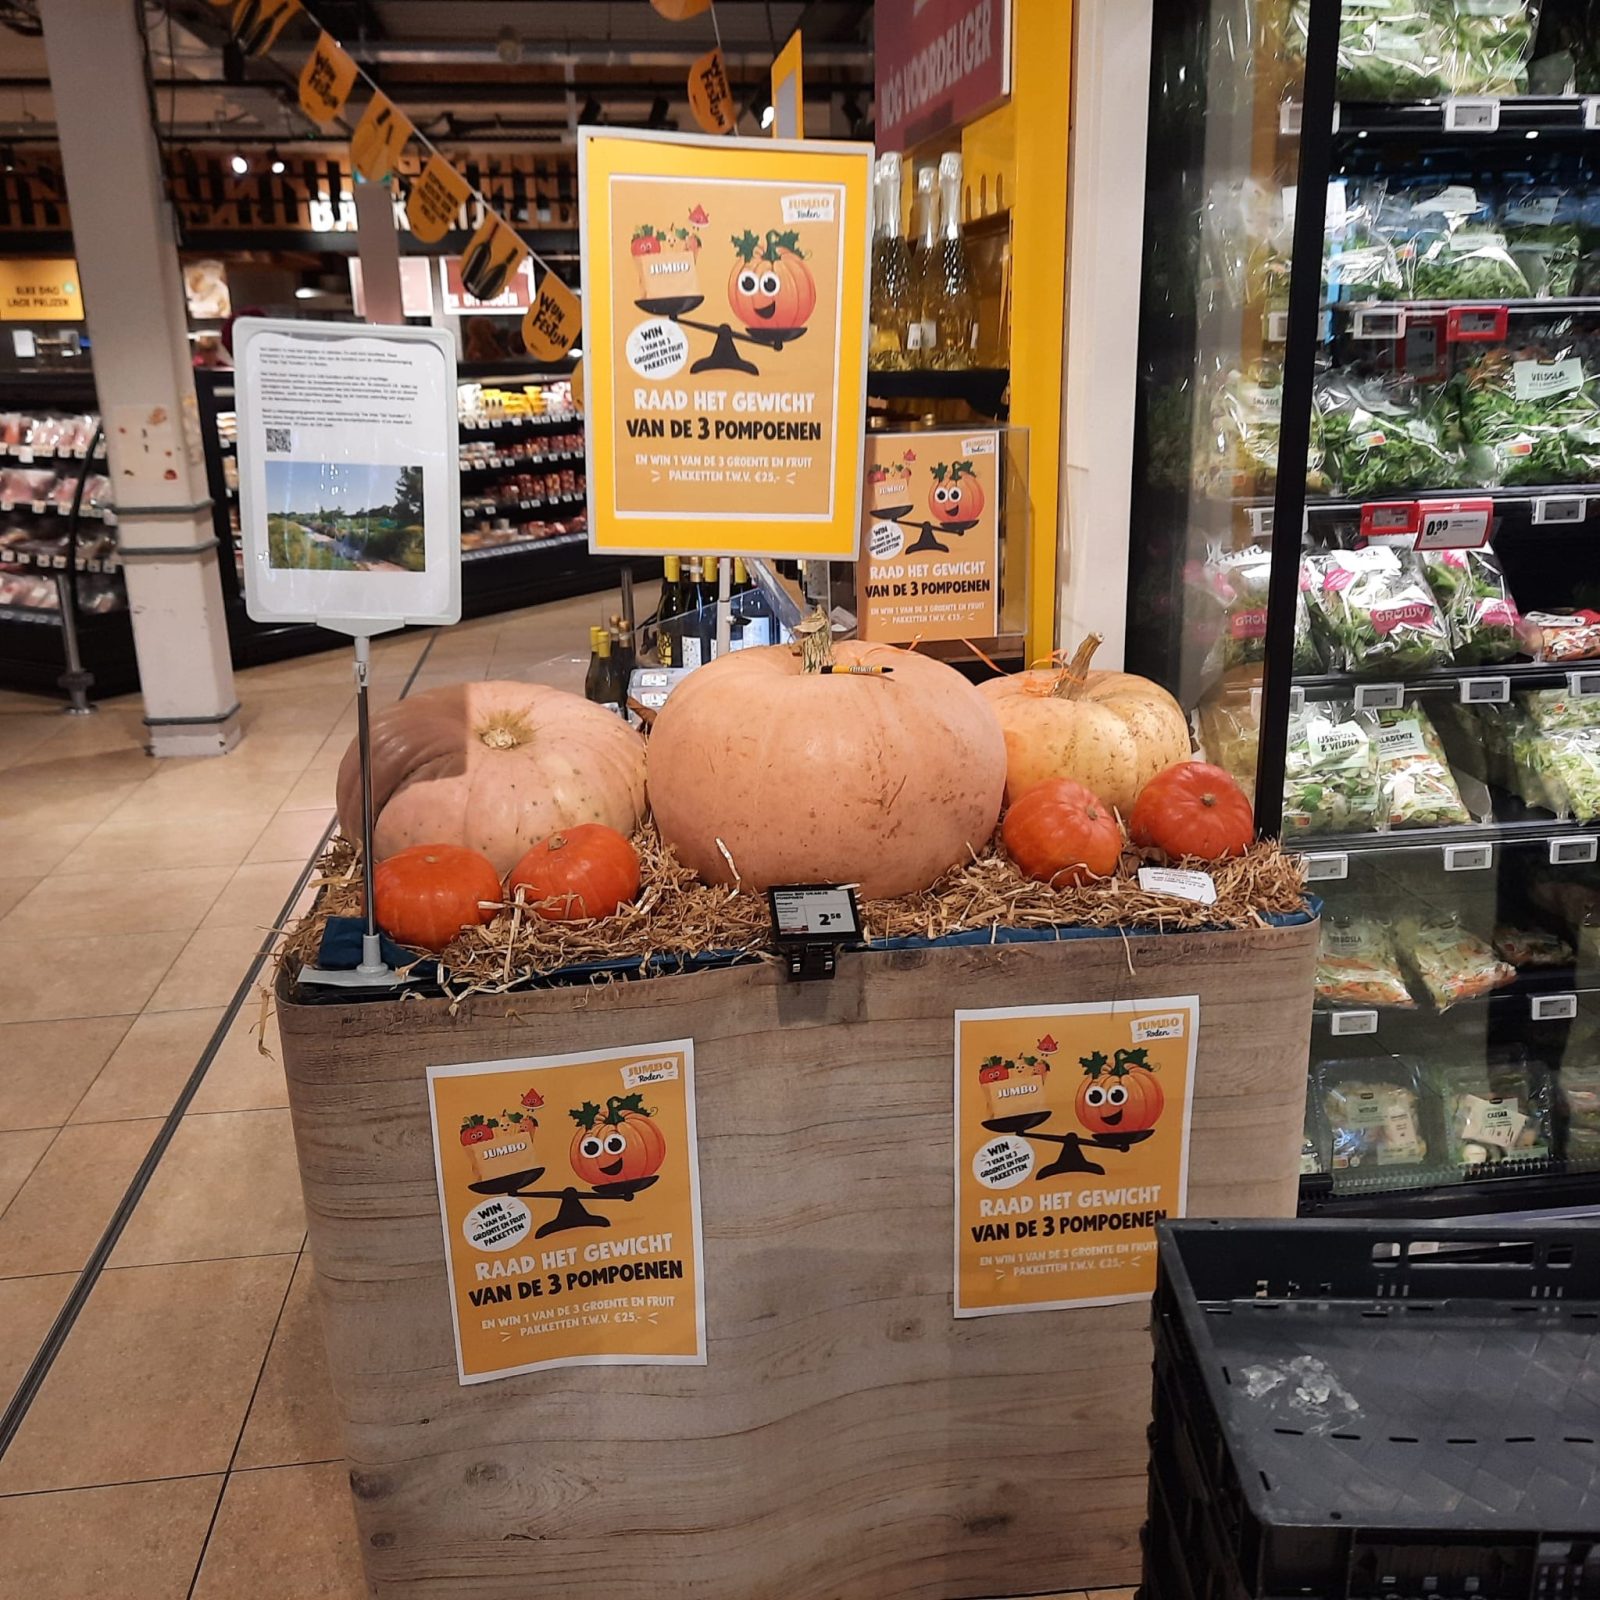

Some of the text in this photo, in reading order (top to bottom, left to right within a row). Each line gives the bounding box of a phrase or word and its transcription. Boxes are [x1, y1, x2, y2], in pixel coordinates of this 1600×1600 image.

[903, 0, 992, 115] VOORDELIGER
[788, 198, 830, 209] JUMBO
[649, 262, 690, 275] JUMBO
[640, 325, 663, 341] WIN
[644, 353, 682, 372] PAKKETTEN
[633, 388, 815, 413] RAAD HET GEWICHT
[626, 417, 821, 440] VAN DE 3 POMPOENEN
[635, 454, 812, 468] EN WIN 1 VAN DE 3 GROENTE EN FRUIT
[669, 470, 780, 483] PAKKETTEN T.W.V. €25,-
[870, 561, 986, 580] RAAD HET GEWICHT
[865, 579, 990, 598] VAN DE 3 POMPOENEN
[1375, 605, 1426, 623] GROWY
[1329, 739, 1360, 751] VELDSLA
[1137, 1017, 1180, 1031] JUMBO
[1146, 1029, 1170, 1038] Roden
[628, 1060, 673, 1077] JUMBO
[638, 1073, 663, 1083] Roden
[997, 1084, 1037, 1099] JUMBO
[483, 1142, 527, 1160] JUMBO
[987, 1141, 1010, 1156] WIN
[980, 1153, 1030, 1178] GROENTE EN FRUIT
[991, 1156, 1004, 1164] VAN
[990, 1163, 1028, 1183] PAKKETTEN
[980, 1185, 1161, 1218] RAAD HET GEWICHT
[477, 1203, 503, 1220] WIN
[484, 1218, 498, 1228] VAN
[498, 1214, 507, 1222] DE
[473, 1213, 526, 1241] GROENTE EN FRUIT
[484, 1223, 524, 1246] PAKKETTEN
[971, 1210, 1167, 1243] VAN DE 3 POMPOENEN
[475, 1233, 673, 1281] RAAD HET GEWICHT
[980, 1240, 1158, 1266] EN WIN 1 VAN DE 3 GROENTE EN FRUIT
[1013, 1257, 1124, 1277] PAKKETTEN T.W.V. €25,-
[468, 1260, 683, 1307] VAN DE 3 POMPOENEN
[481, 1296, 675, 1330] EN WIN 1 VAN DE 3 GROENTE EN FRUIT
[520, 1311, 641, 1337] PAKKETTEN T.W.V. €25,-
